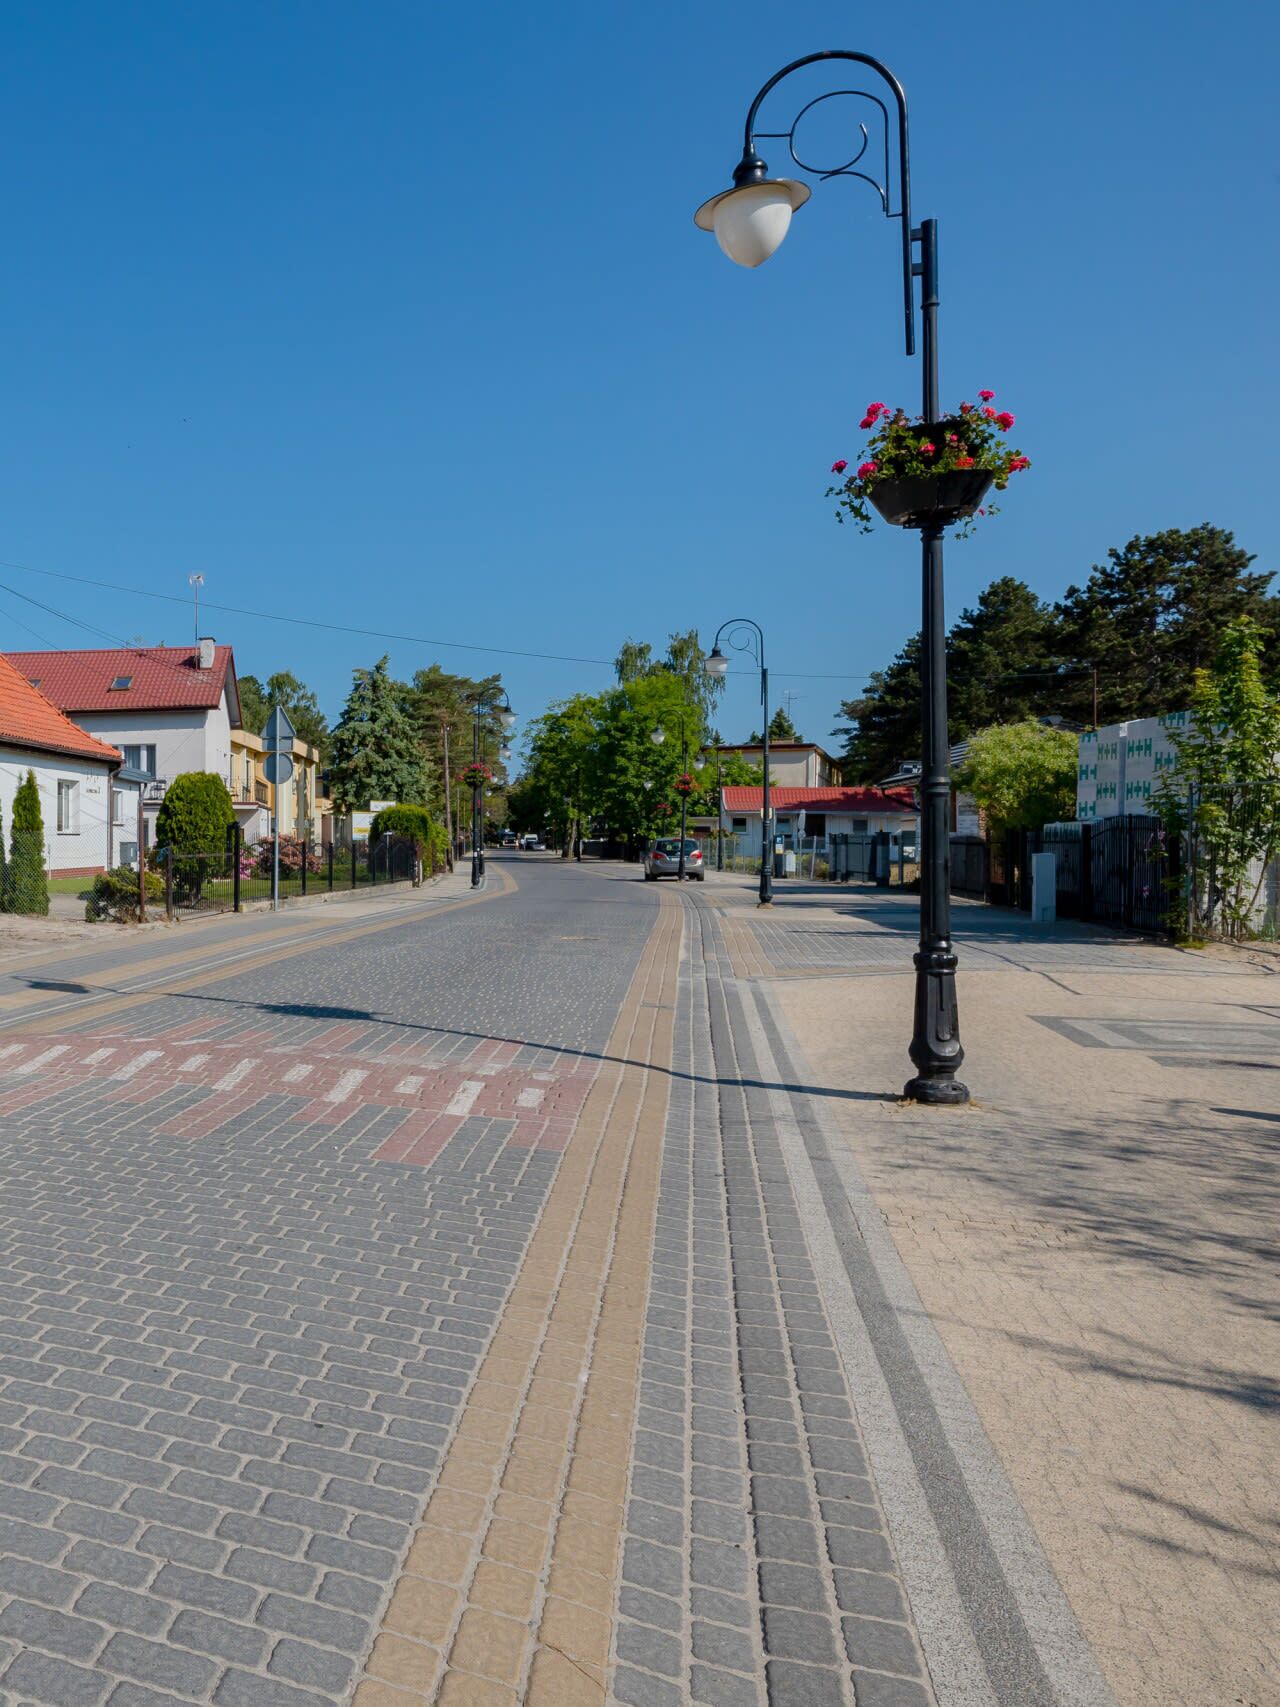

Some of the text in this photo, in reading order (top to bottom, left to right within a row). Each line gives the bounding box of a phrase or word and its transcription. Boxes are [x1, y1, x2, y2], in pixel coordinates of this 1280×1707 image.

[1097, 742, 1118, 761] H+H
[1127, 737, 1153, 759] H+H
[1096, 782, 1117, 801] H+H
[1126, 780, 1152, 801] H+H
